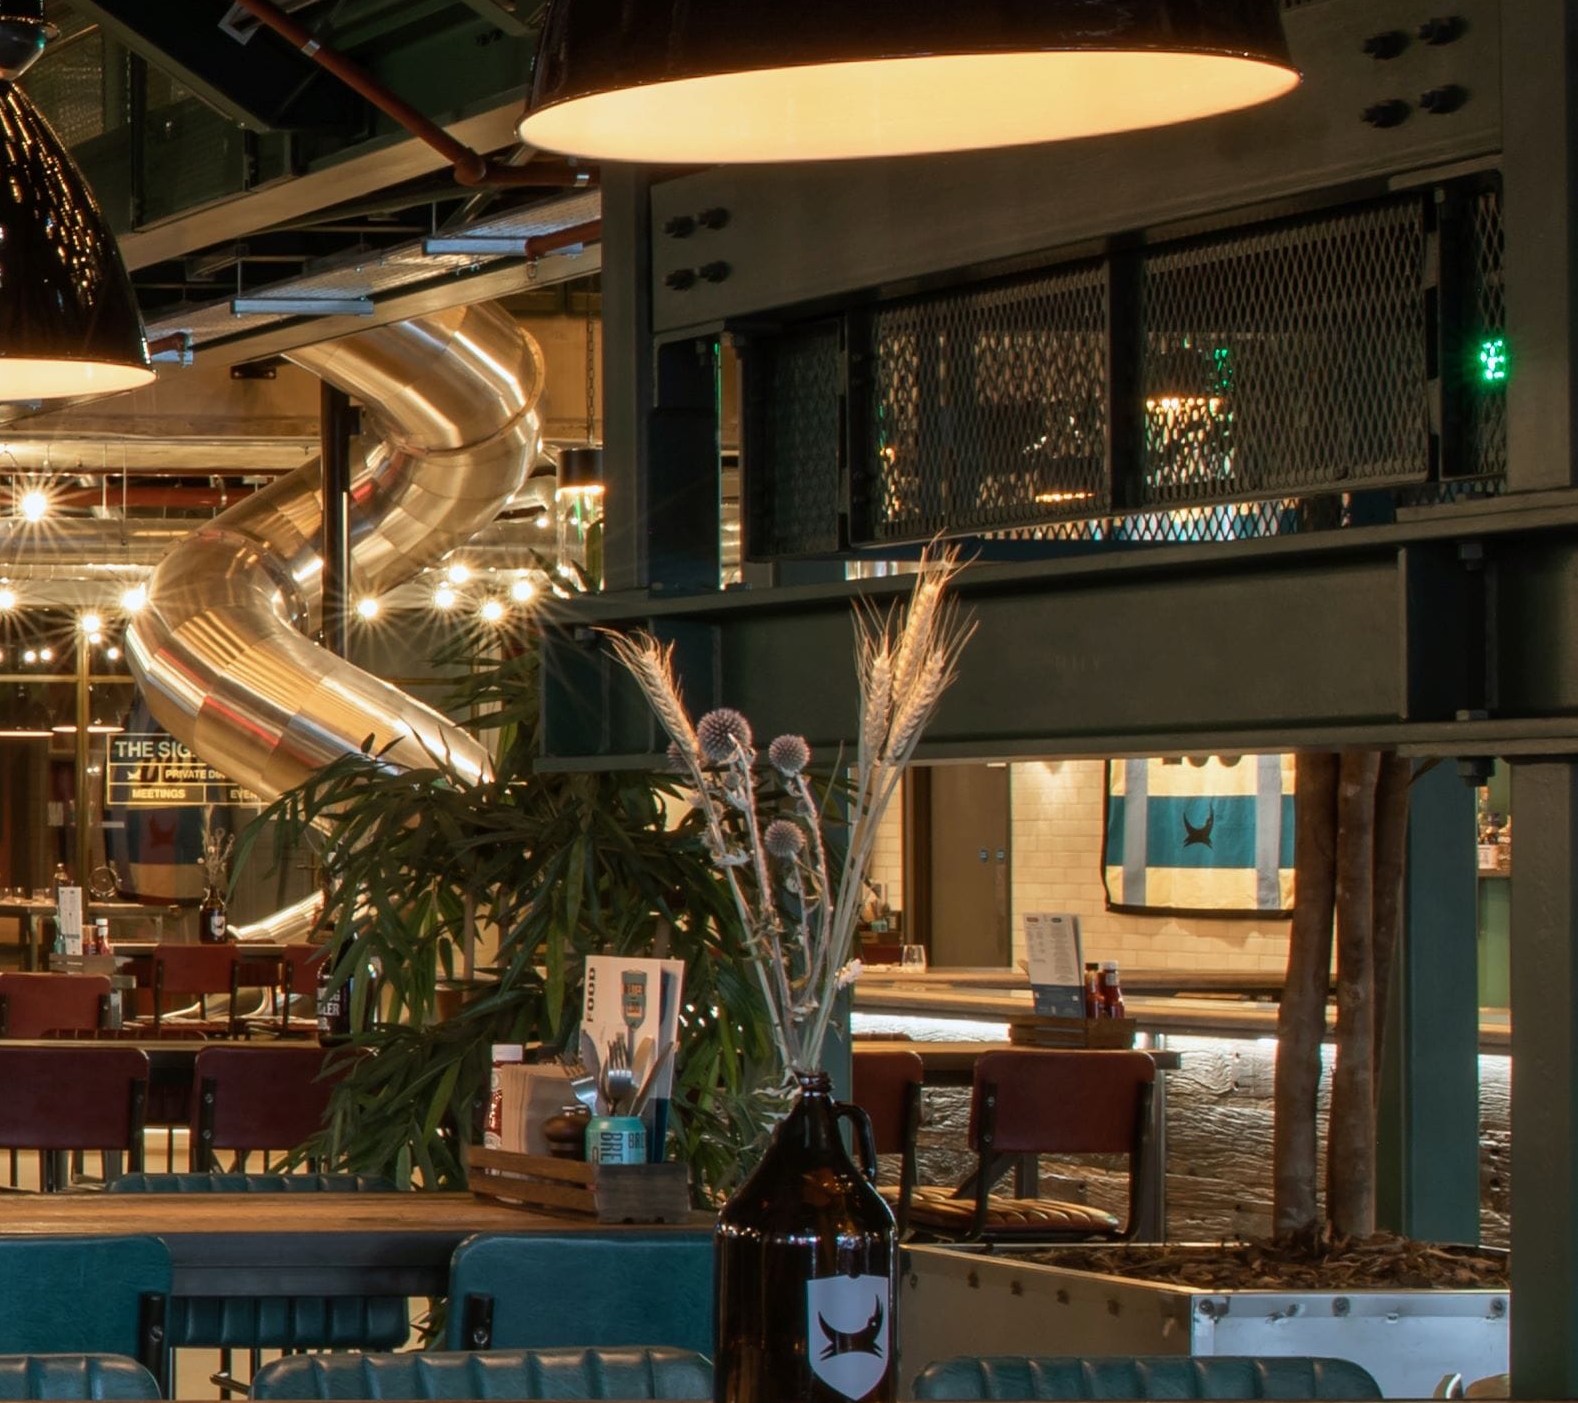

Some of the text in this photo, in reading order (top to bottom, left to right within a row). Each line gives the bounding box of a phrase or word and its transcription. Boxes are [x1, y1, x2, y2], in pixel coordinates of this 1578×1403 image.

[115, 741, 196, 757] THE SIG
[165, 769, 207, 779] PRIVATE
[132, 788, 185, 799] MEETINGS
